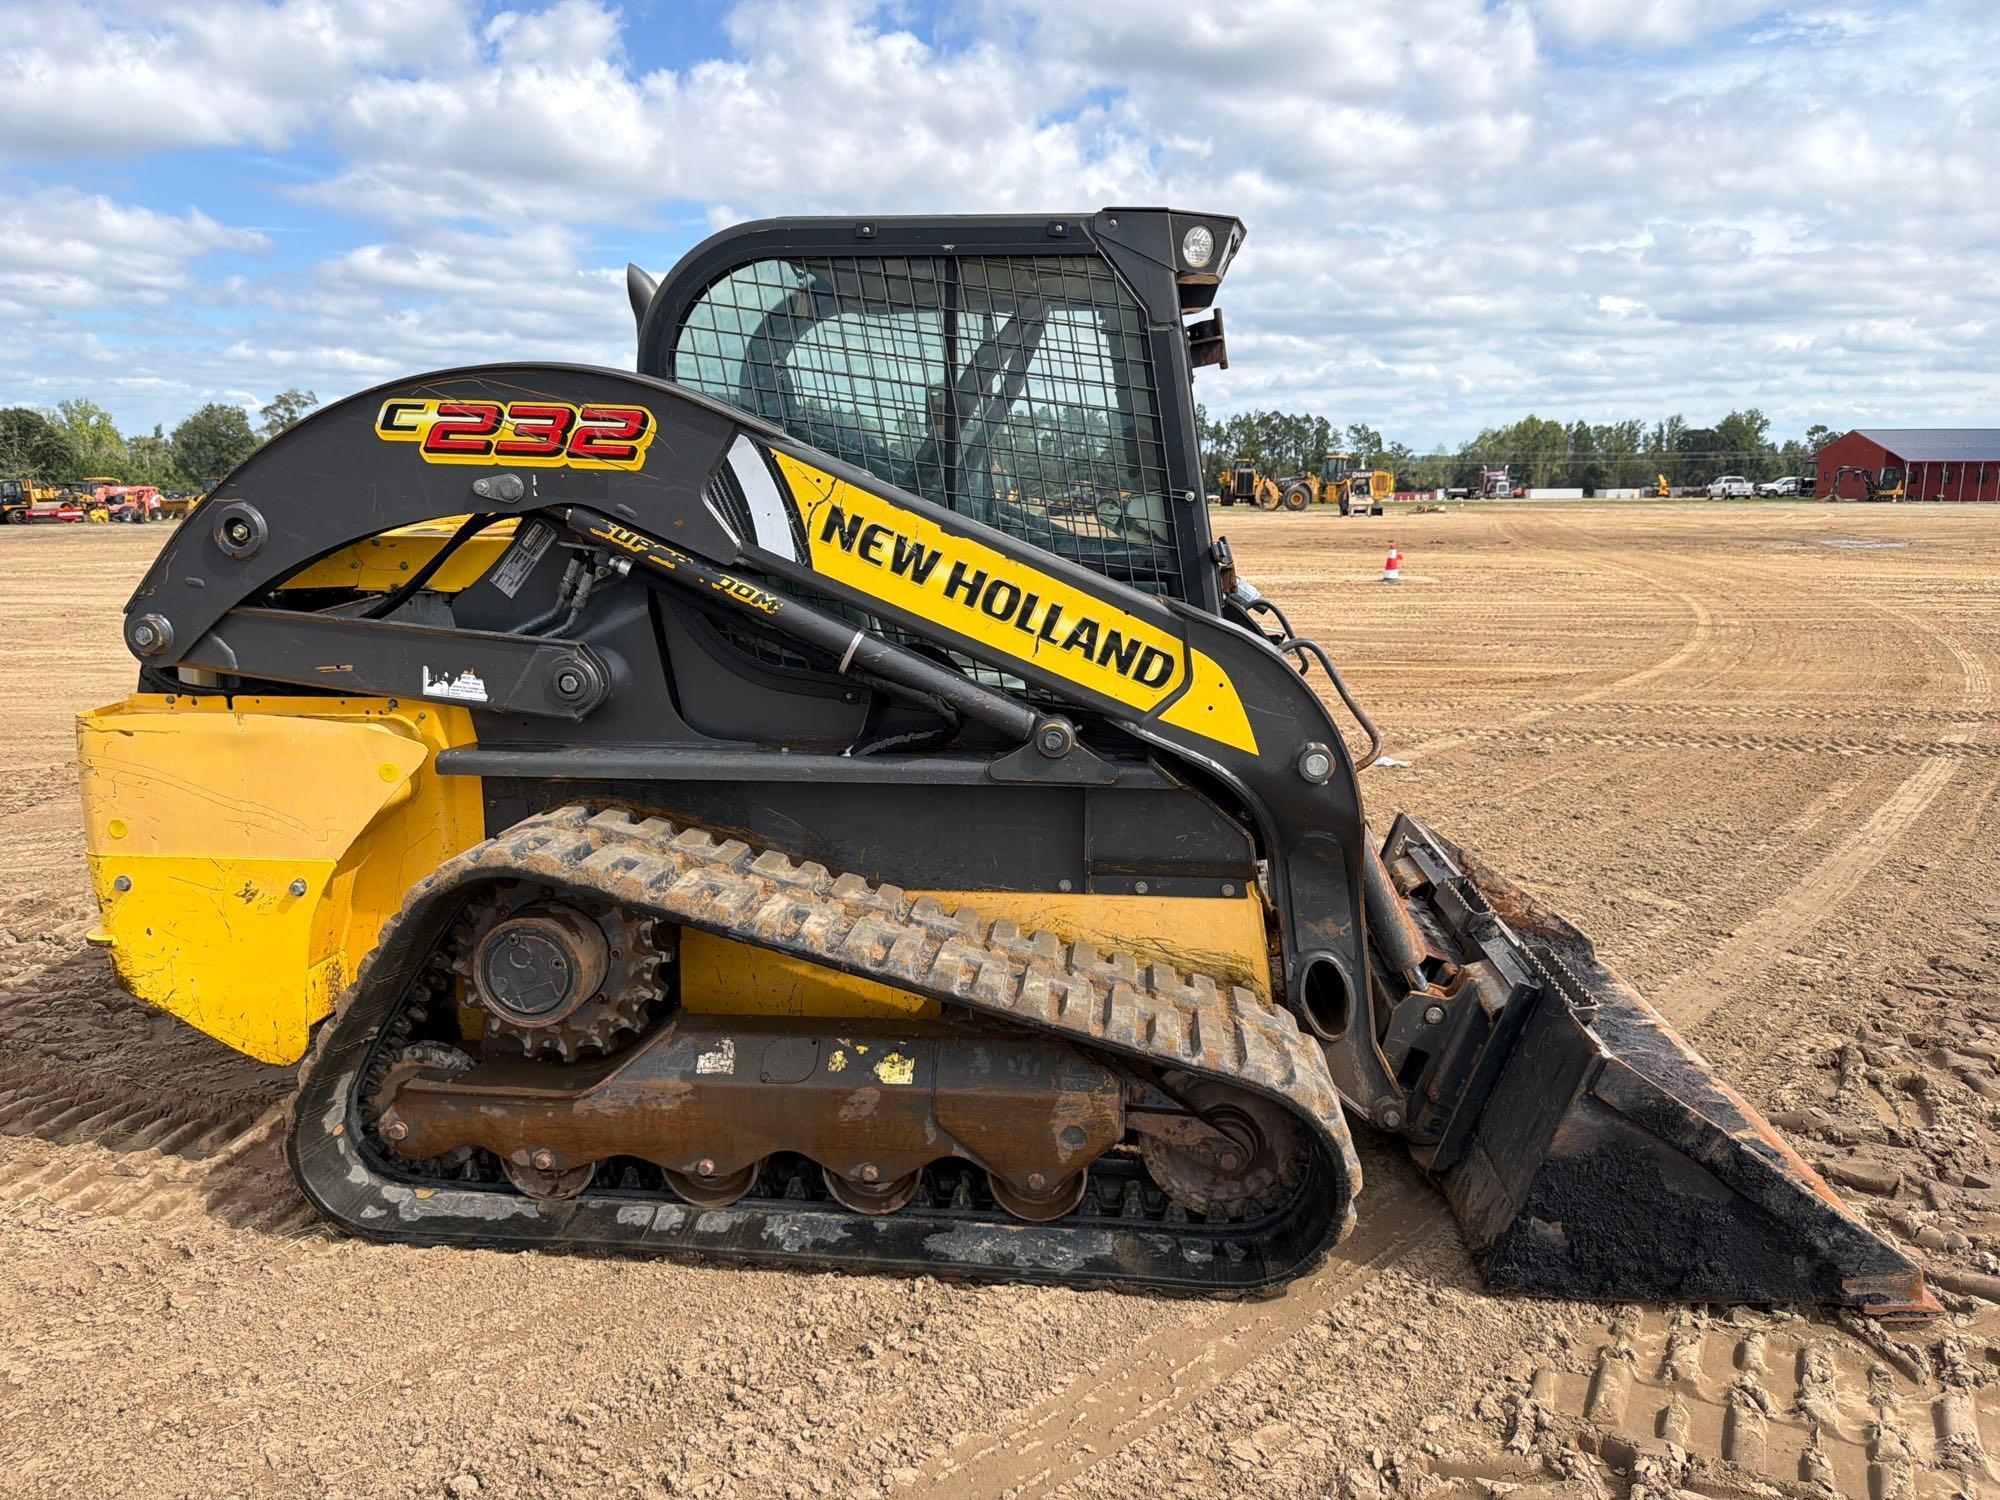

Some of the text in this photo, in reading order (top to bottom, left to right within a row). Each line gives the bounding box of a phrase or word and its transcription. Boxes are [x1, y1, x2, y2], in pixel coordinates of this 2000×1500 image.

[378, 401, 653, 465] C232
[590, 518, 694, 570] SUP
[699, 567, 784, 615] OOM
[818, 505, 1177, 690] NEW HOLLAND
